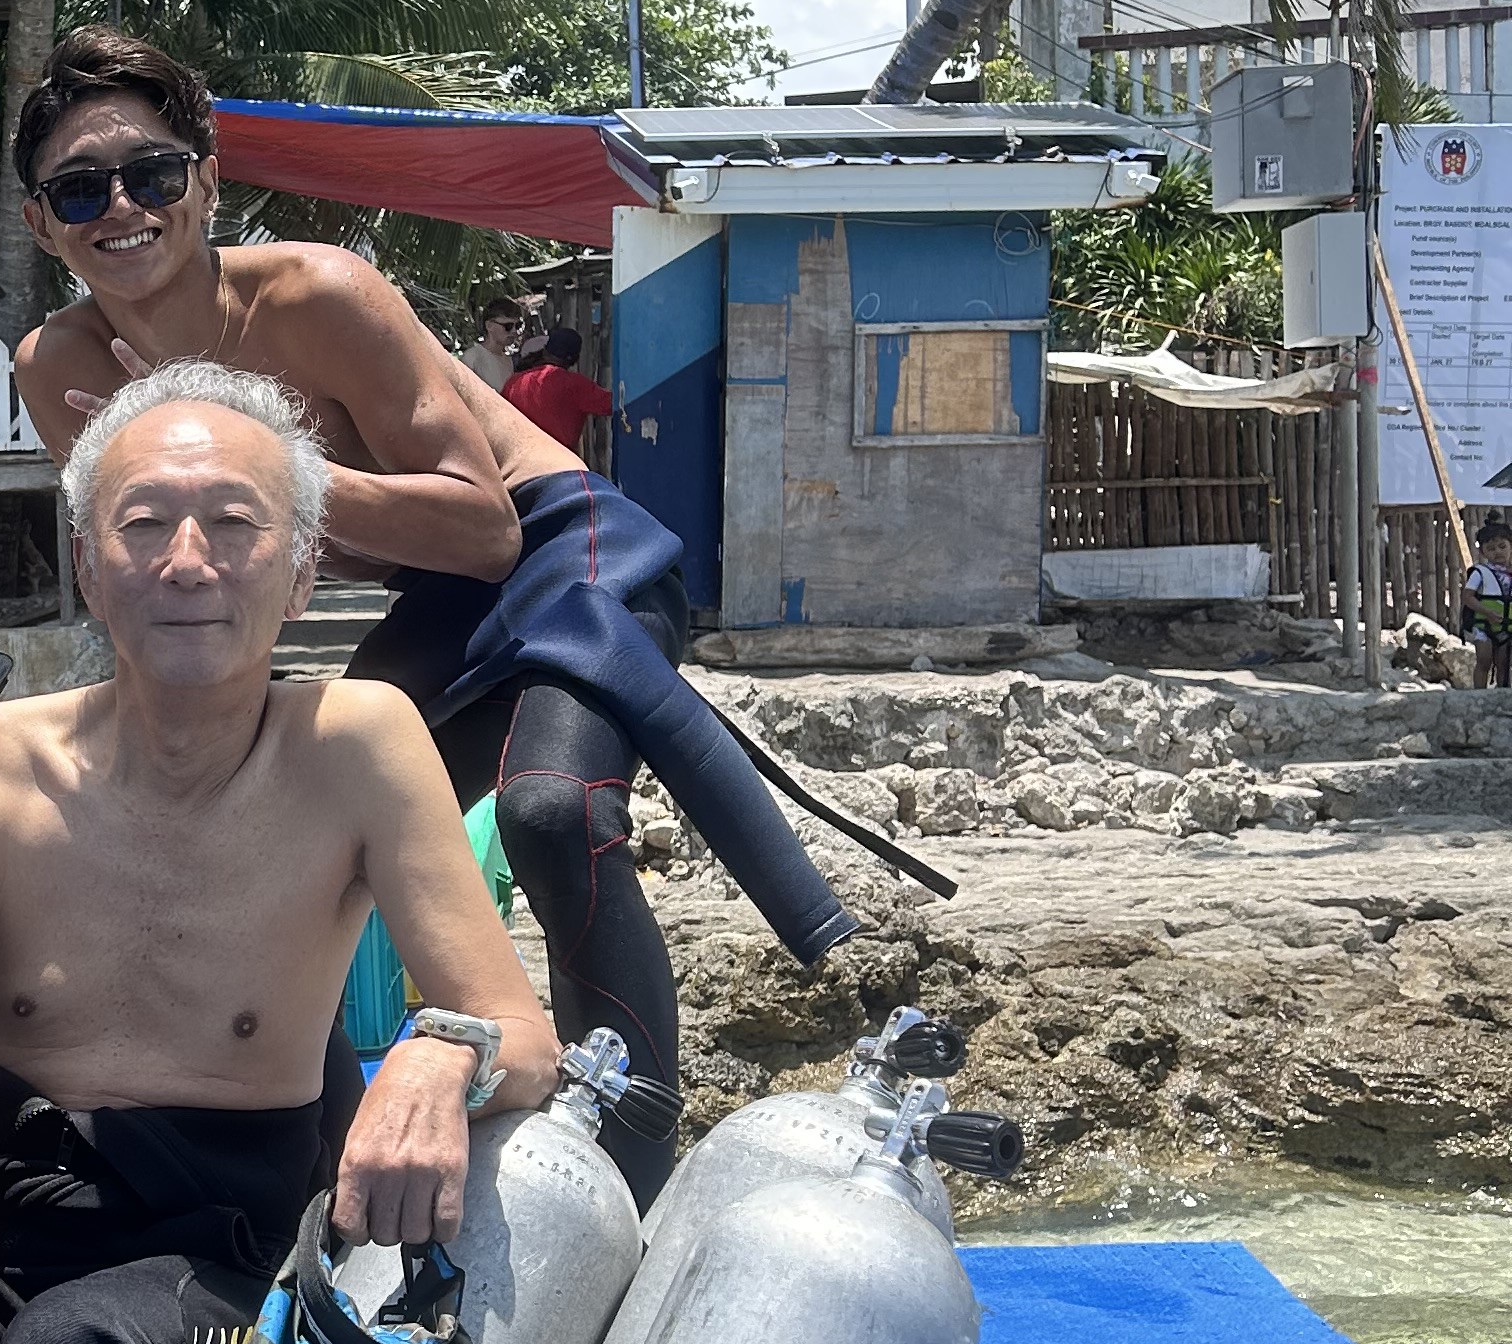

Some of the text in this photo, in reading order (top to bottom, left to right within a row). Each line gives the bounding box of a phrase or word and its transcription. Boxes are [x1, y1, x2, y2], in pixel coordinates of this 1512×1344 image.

[1419, 205, 1454, 213] PURCHASE
[1410, 250, 1450, 258] Development
[1410, 265, 1475, 273] Implementing Agency
